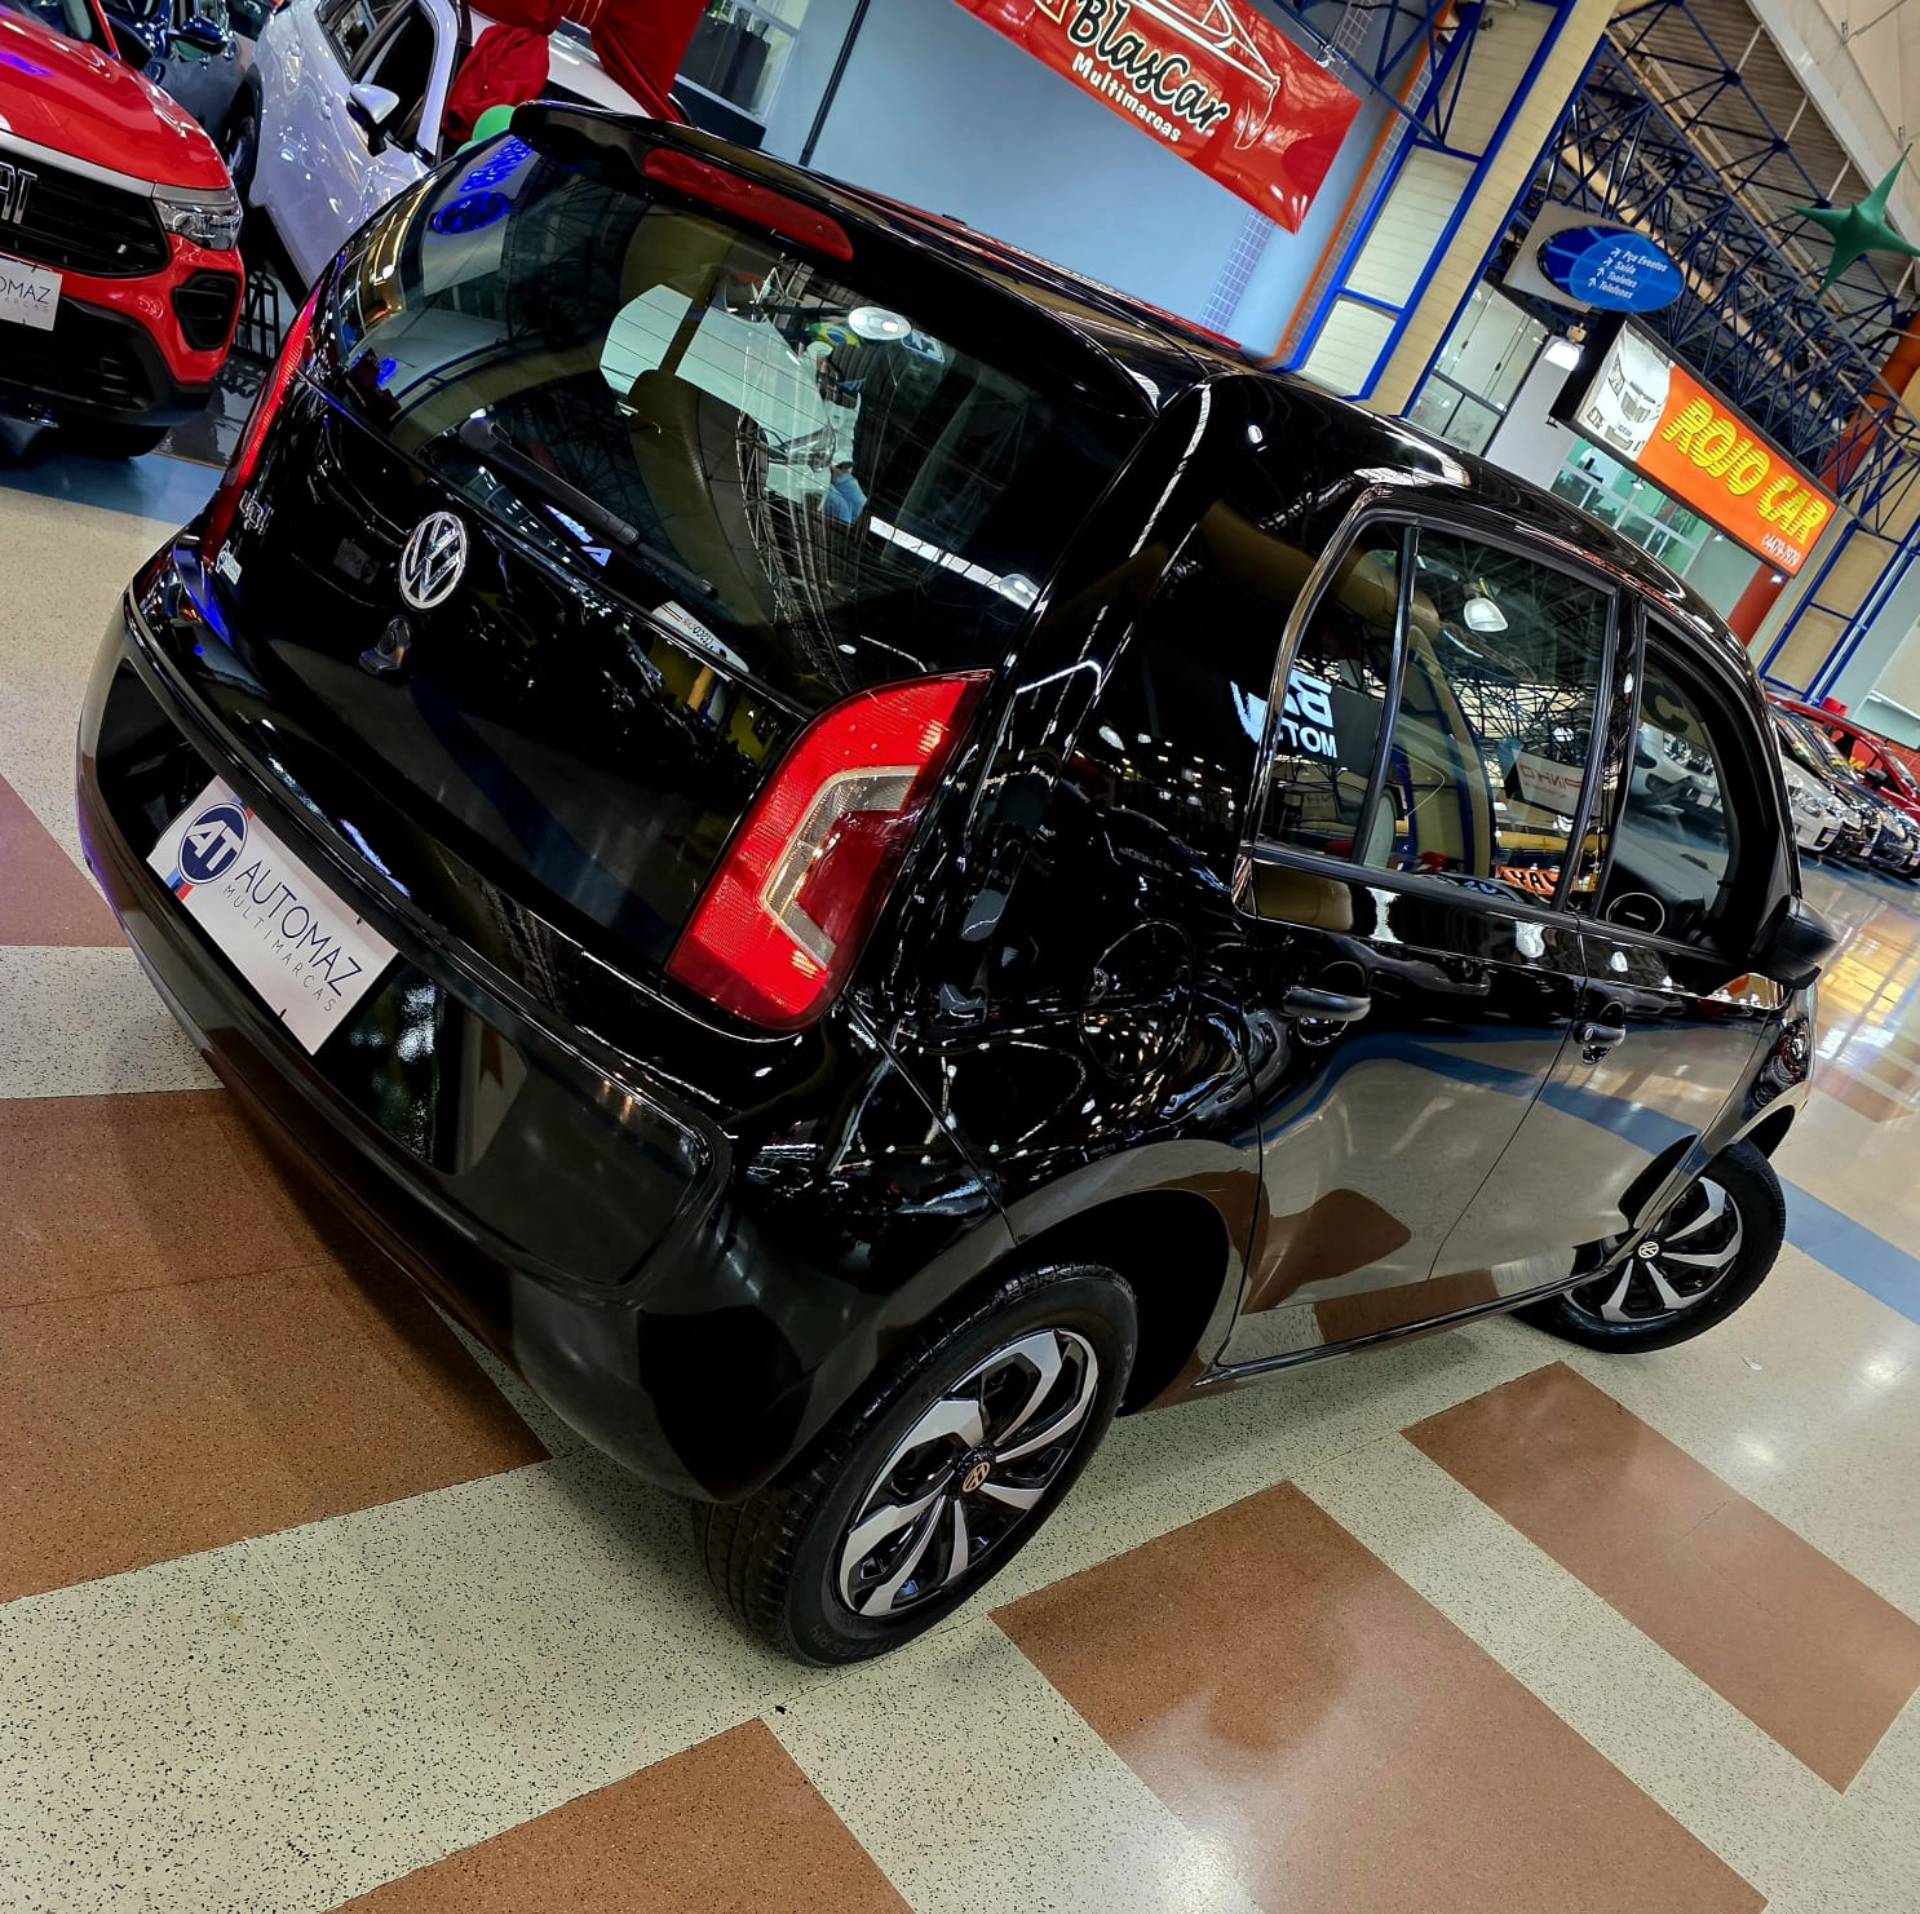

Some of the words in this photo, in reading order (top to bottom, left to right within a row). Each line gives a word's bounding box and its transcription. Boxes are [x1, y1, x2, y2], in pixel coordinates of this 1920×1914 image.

[1067, 0, 1230, 137] BlasCar
[1072, 52, 1181, 142] Multimarcas
[1638, 255, 1667, 271] Eventos
[1662, 397, 1769, 495] ROJO
[1758, 475, 1827, 545] CAR
[223, 885, 337, 1012] MULTIMARCAS
[234, 860, 362, 997] AUTOMAZ
